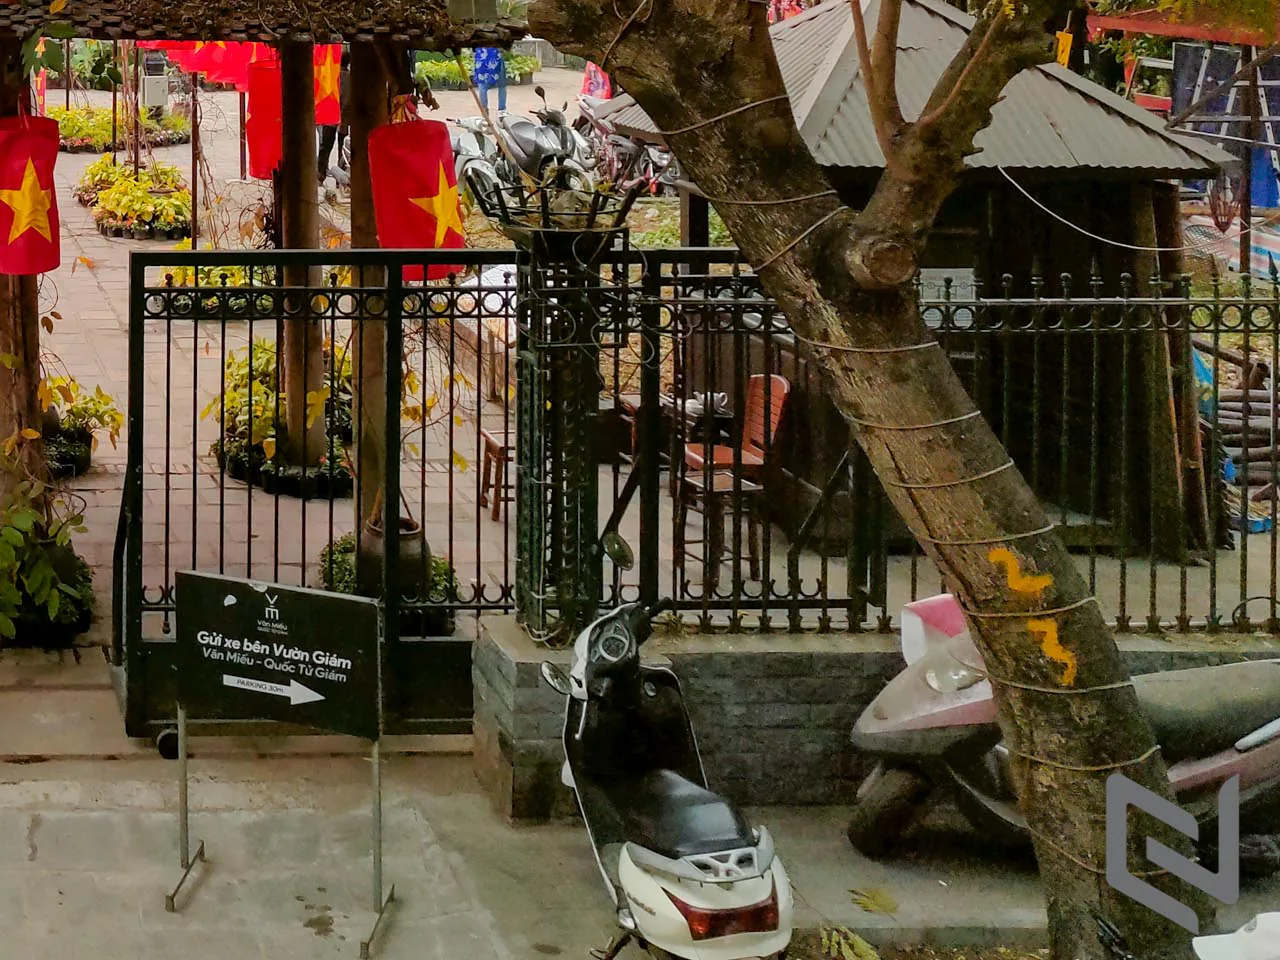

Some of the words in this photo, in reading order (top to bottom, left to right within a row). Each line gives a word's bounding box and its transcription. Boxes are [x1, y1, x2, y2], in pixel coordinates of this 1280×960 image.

[197, 631, 222, 646] Gửi
[224, 637, 241, 650] xe
[243, 638, 270, 654] bên
[273, 643, 309, 661] Vườn
[312, 650, 352, 669] Giám
[203, 646, 224, 661] Văn
[226, 649, 255, 666] Miếu
[263, 658, 296, 674] Quốc
[298, 663, 314, 676] Tử
[315, 667, 347, 683] Giám
[236, 679, 267, 690] PARKING
